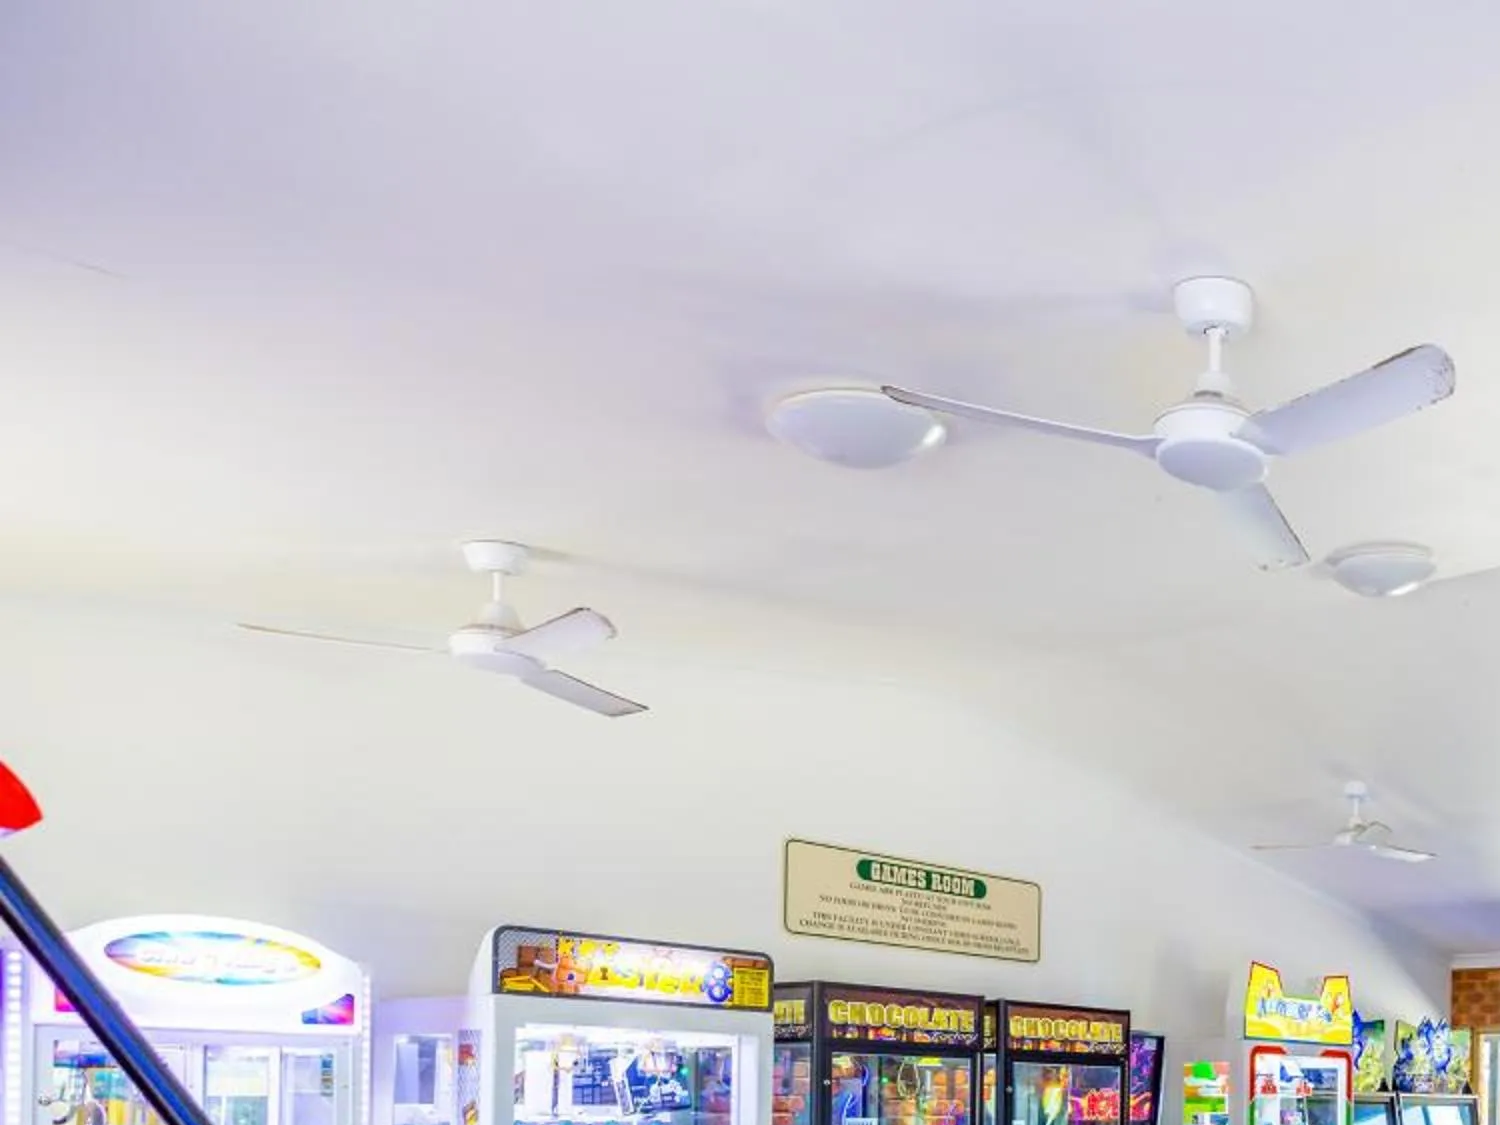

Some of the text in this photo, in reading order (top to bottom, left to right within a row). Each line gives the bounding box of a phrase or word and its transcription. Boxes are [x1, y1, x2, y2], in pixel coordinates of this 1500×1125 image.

[871, 861, 976, 897] GAMES ROOM
[828, 1000, 975, 1033] CHOCOLATE
[1009, 1015, 1123, 1042] CHOCOLATE
